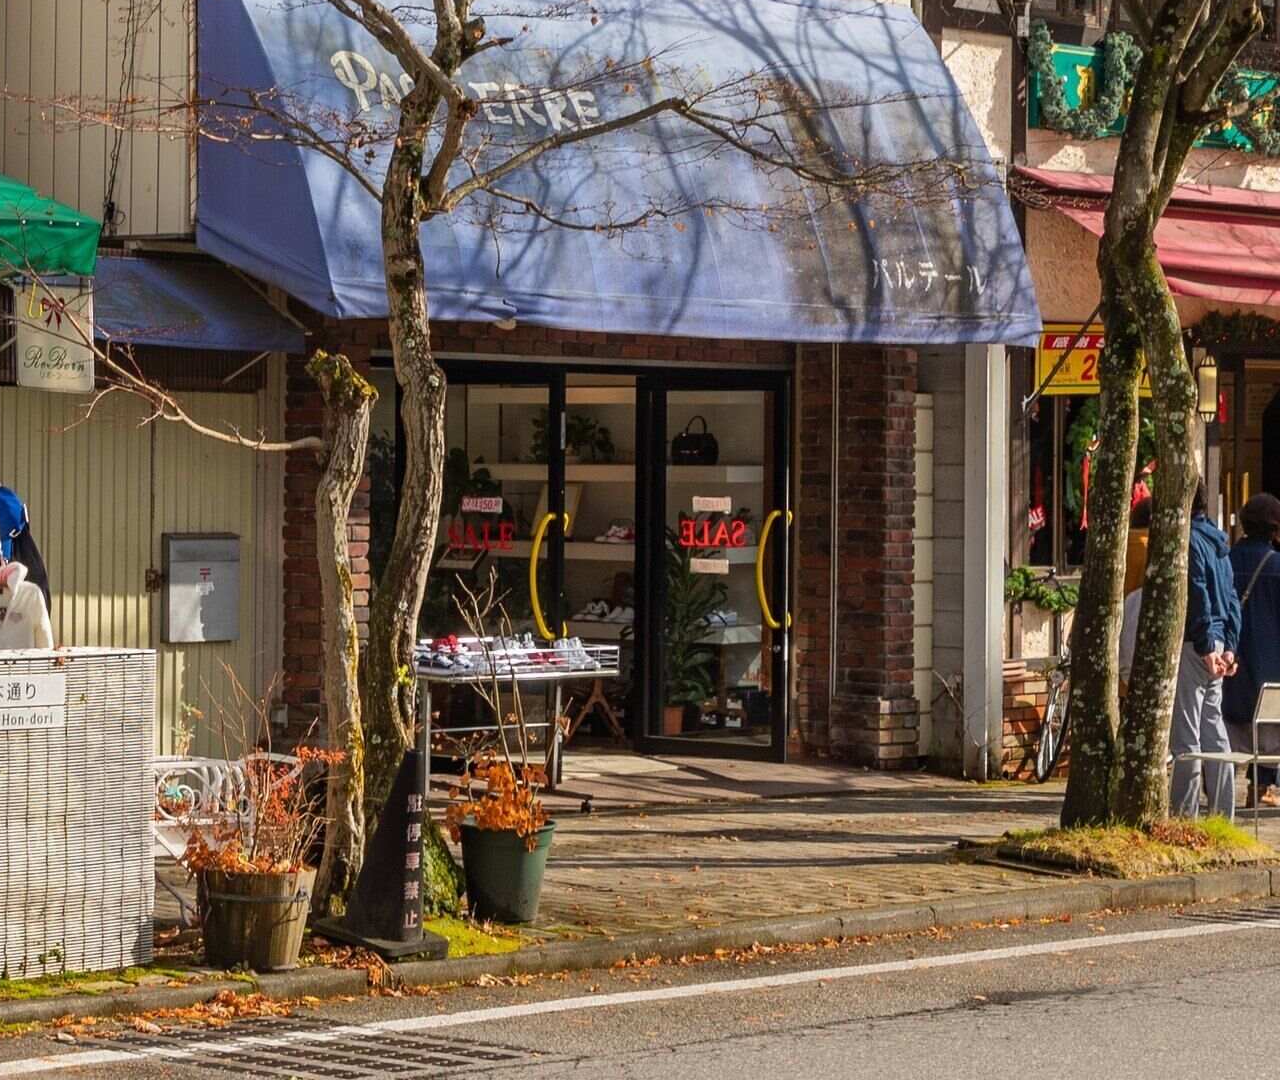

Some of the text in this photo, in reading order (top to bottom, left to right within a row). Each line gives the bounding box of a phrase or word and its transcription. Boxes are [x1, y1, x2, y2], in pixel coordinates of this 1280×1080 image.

[330, 50, 602, 131] PAERRE
[872, 259, 987, 295] パルテール
[447, 522, 515, 551] SALE
[1, 712, 53, 726] Hon-dori
[402, 793, 423, 929] 駐停車禁止
